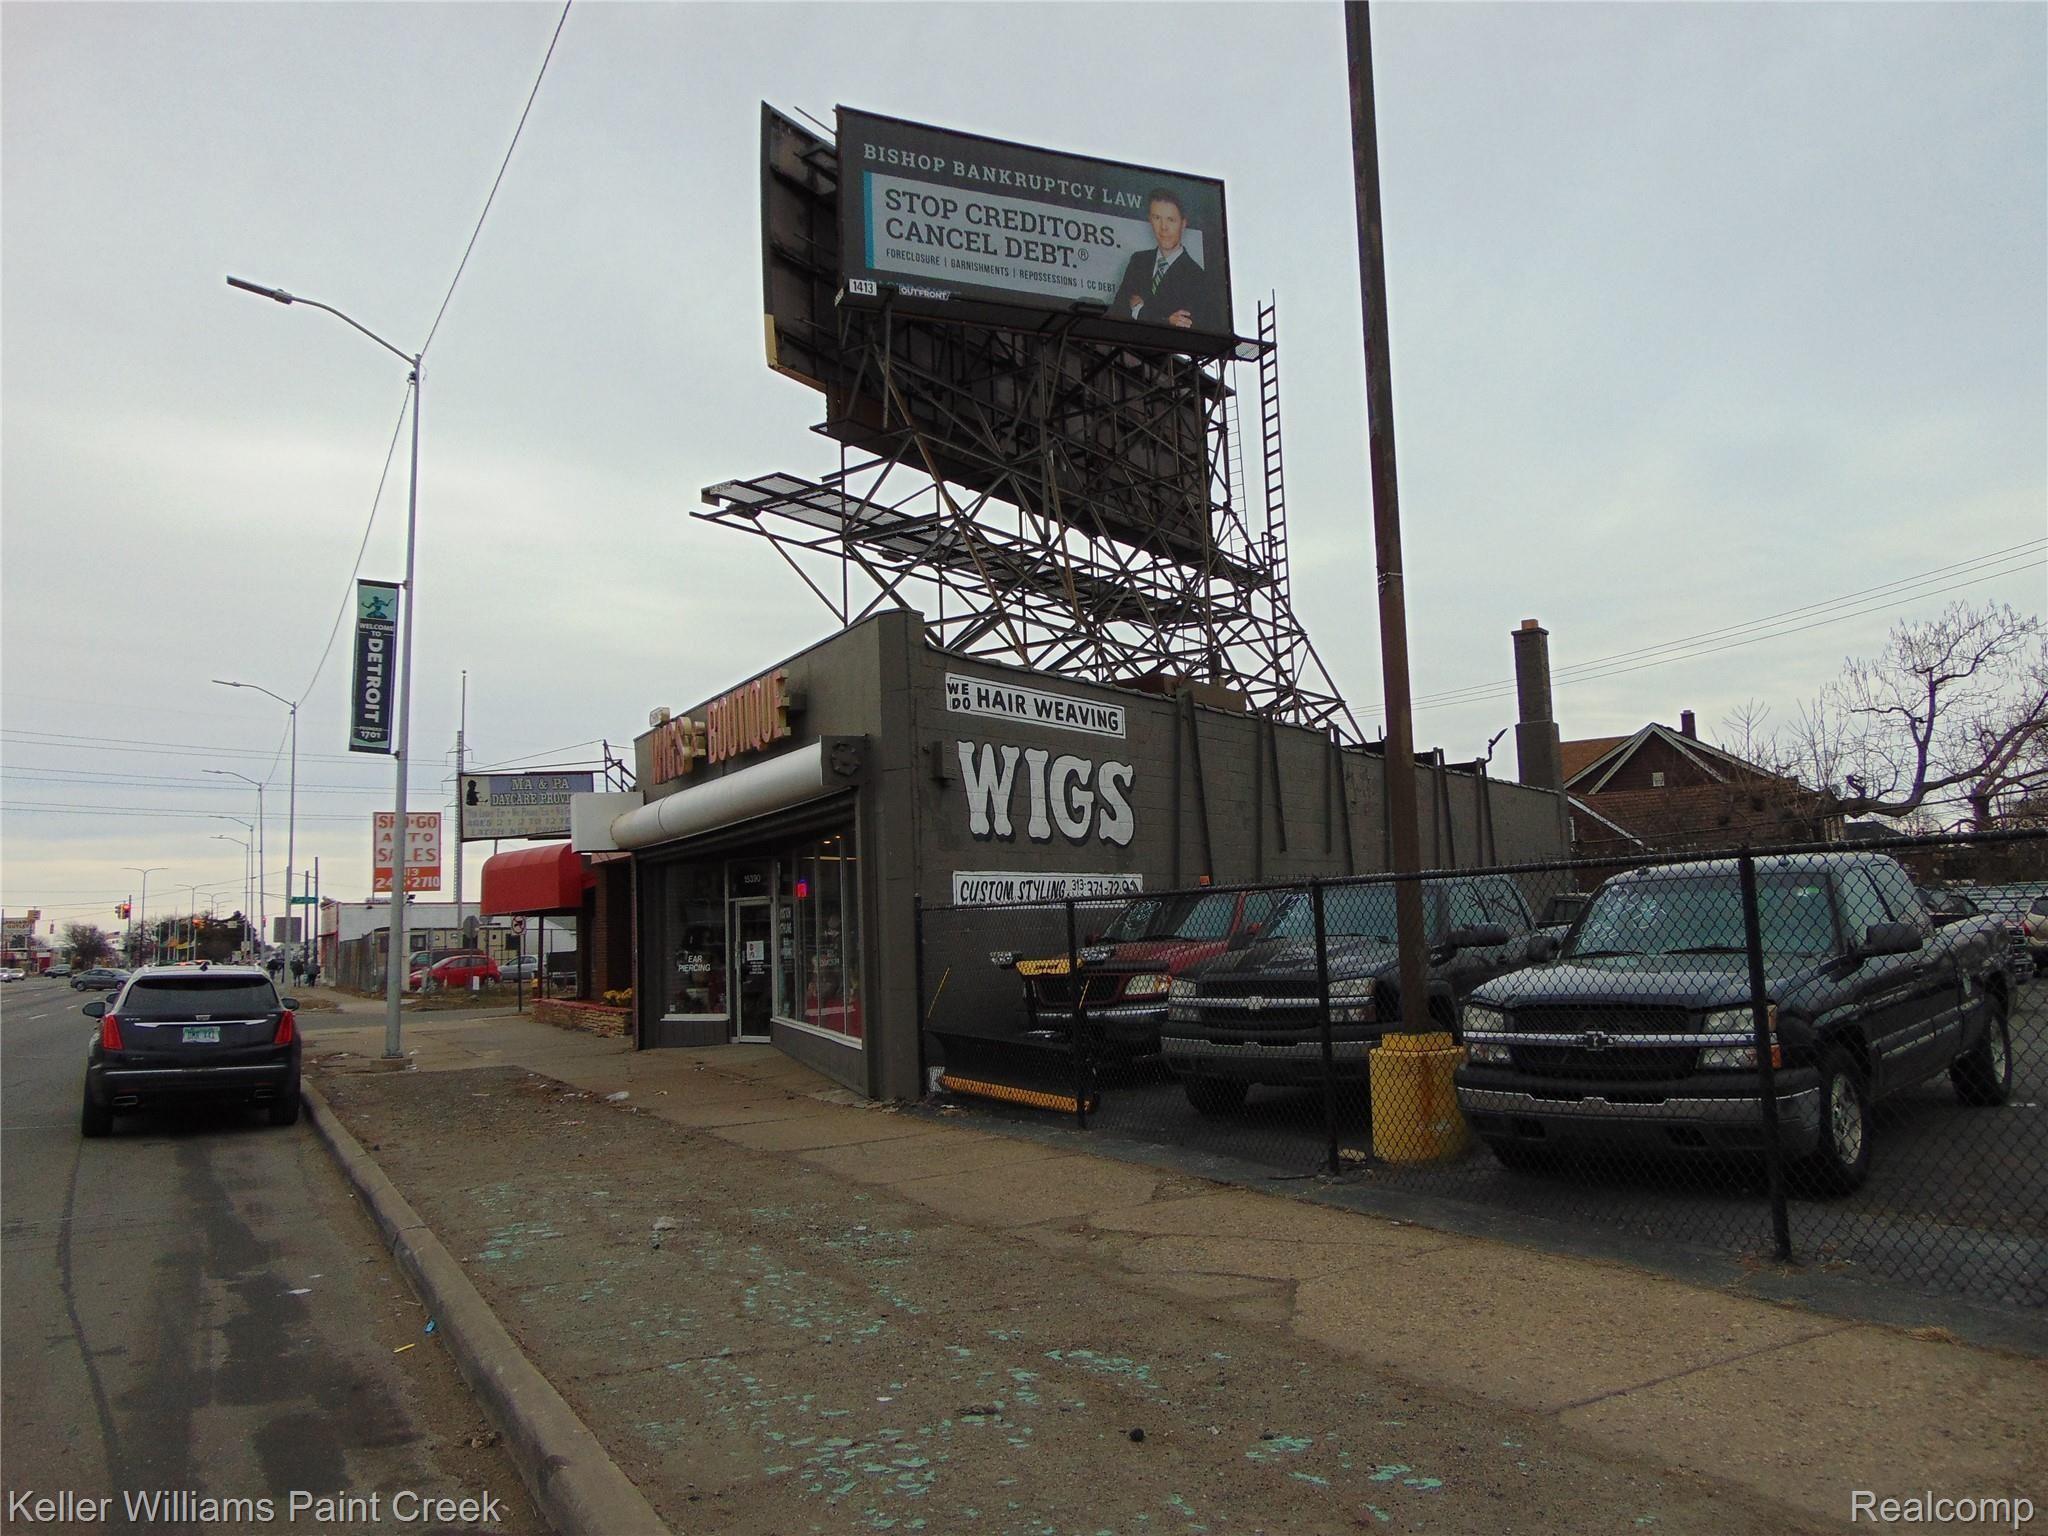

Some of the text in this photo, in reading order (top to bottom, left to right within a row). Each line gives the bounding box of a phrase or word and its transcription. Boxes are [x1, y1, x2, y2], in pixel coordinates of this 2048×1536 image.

[863, 143, 1143, 208] BISHOP BANKRUPTCY LAW
[885, 188, 1122, 249] STOP CREDITORS.
[885, 217, 997, 256] CANCEL
[886, 248, 1117, 292] FORECLOSURE GARNISHMENTS REPOSSESSIONS CC DEBT
[853, 281, 874, 294] 1413
[359, 622, 394, 631] WELCOME
[364, 638, 384, 723] DETROIT
[947, 682, 969, 695] WE
[952, 697, 971, 711] DO
[977, 687, 1119, 731] HAIR WEAVING
[652, 716, 691, 785] WIGS
[707, 668, 791, 764] BOUTIQUE
[360, 731, 381, 739] 1701
[511, 777, 570, 790] MA & PA
[491, 793, 537, 806] DAYCARE
[957, 740, 1135, 846] WIGS
[383, 832, 433, 843] ATO
[378, 847, 437, 862] SES
[960, 879, 1015, 902] CUSTOM
[688, 954, 703, 963] EAR
[678, 963, 711, 972] PIERCING
